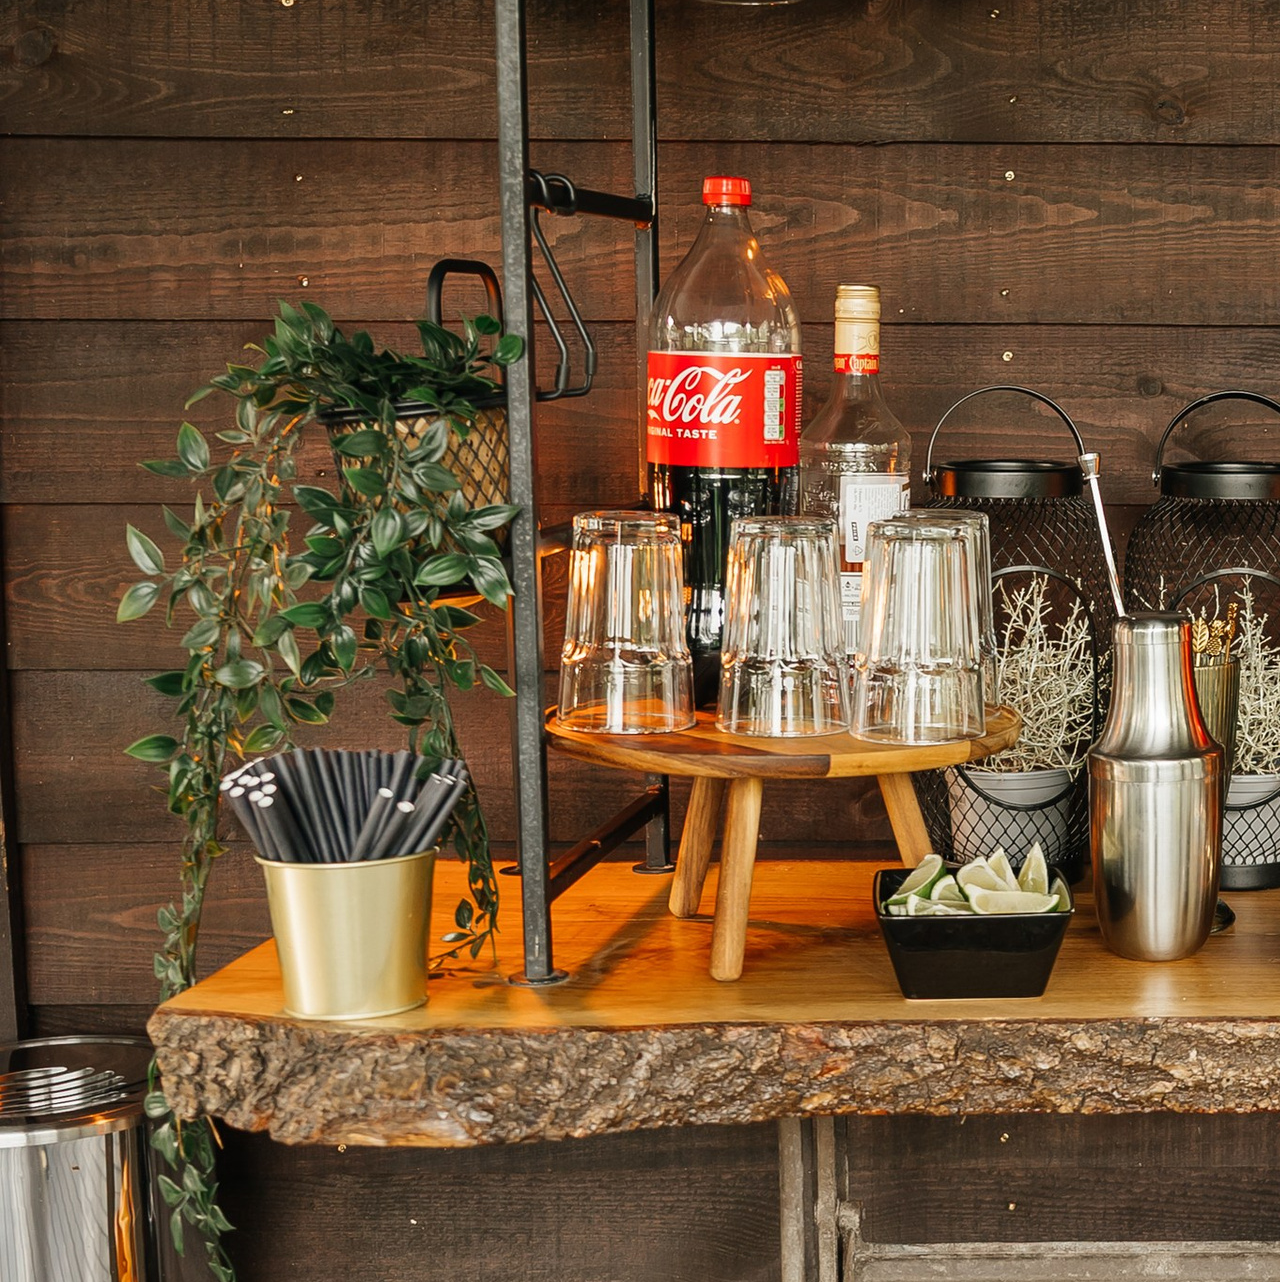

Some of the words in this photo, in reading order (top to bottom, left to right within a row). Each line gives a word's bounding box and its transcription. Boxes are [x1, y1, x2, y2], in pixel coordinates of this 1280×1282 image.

[849, 355, 877, 373] Captain
[648, 366, 753, 424] ca-Cola
[676, 428, 717, 440] TASTE
